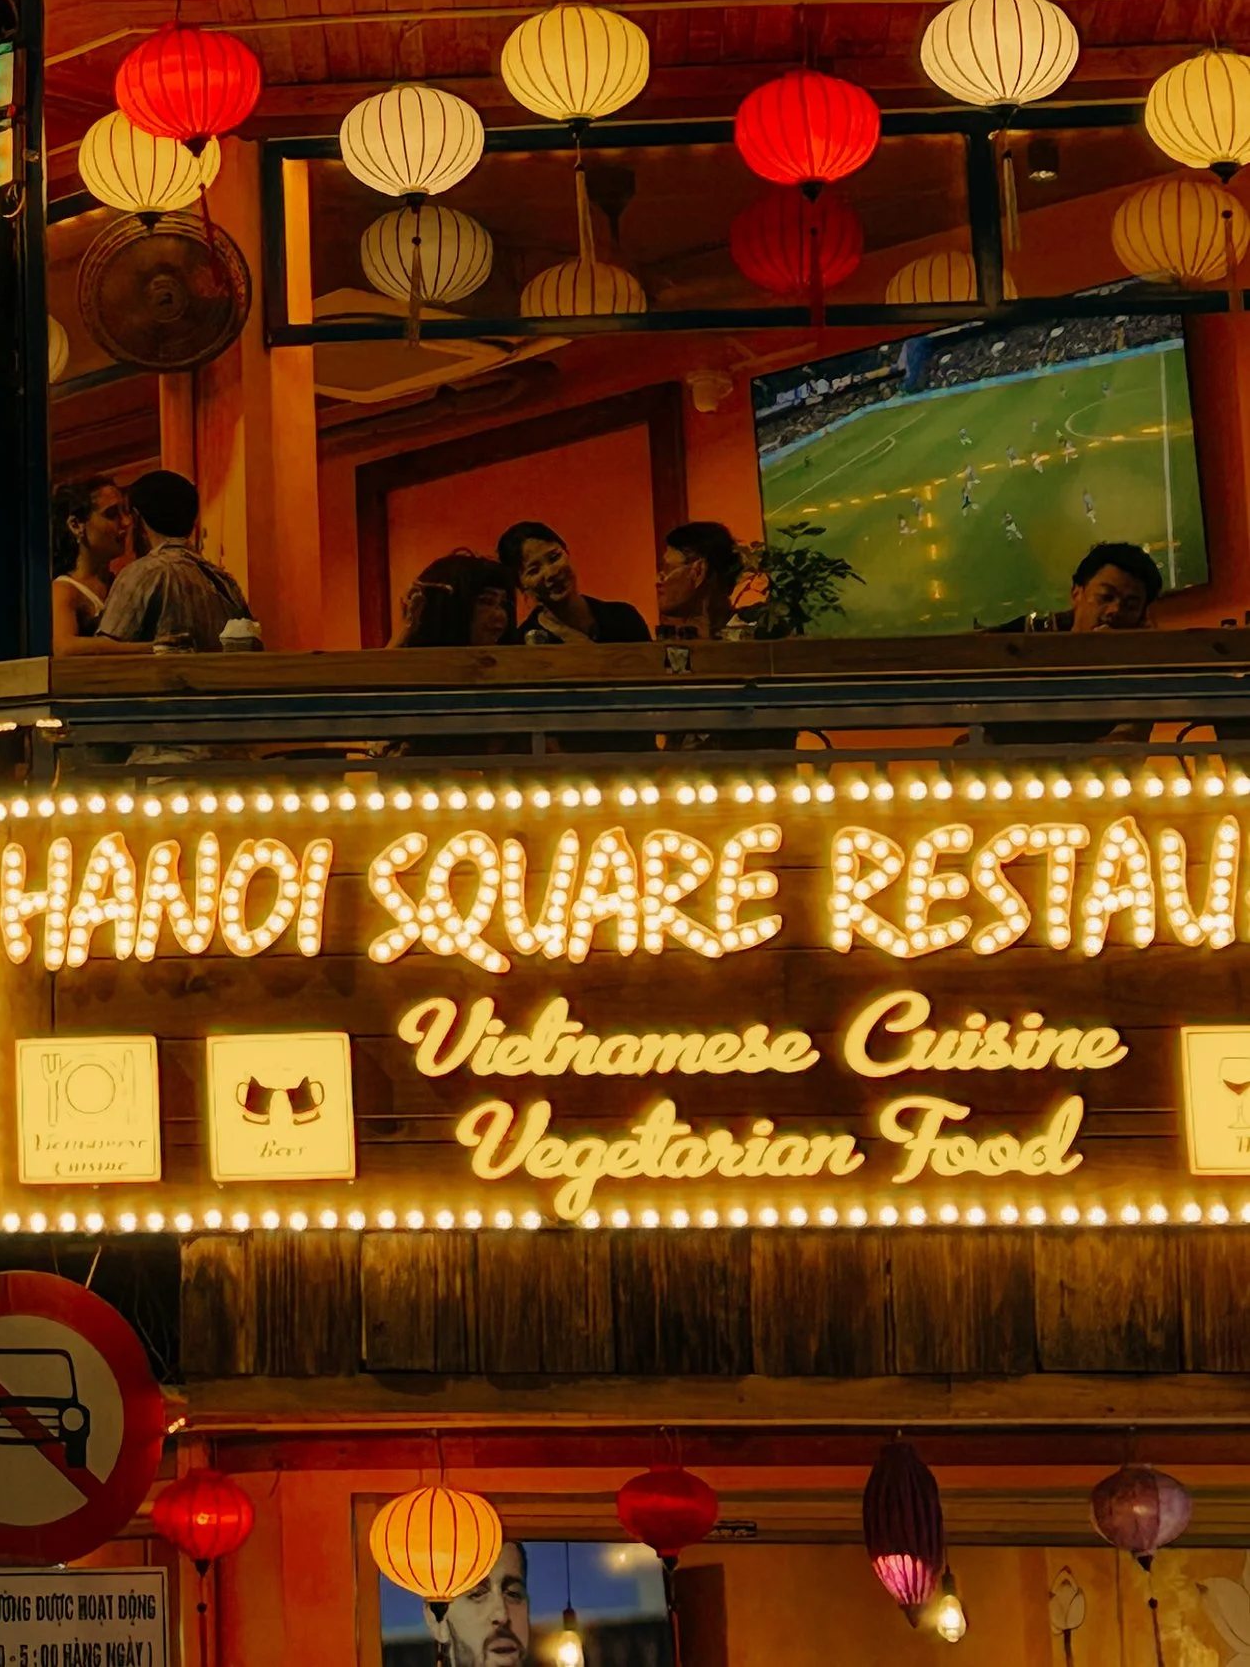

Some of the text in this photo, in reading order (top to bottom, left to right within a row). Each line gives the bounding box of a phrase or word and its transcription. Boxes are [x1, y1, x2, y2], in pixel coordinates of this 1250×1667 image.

[0, 815, 1250, 974] HANOI SQUARE RESTAU
[398, 990, 1128, 1077] Vietnamese Cuisine
[456, 1095, 1084, 1221] Vegetarian Food
